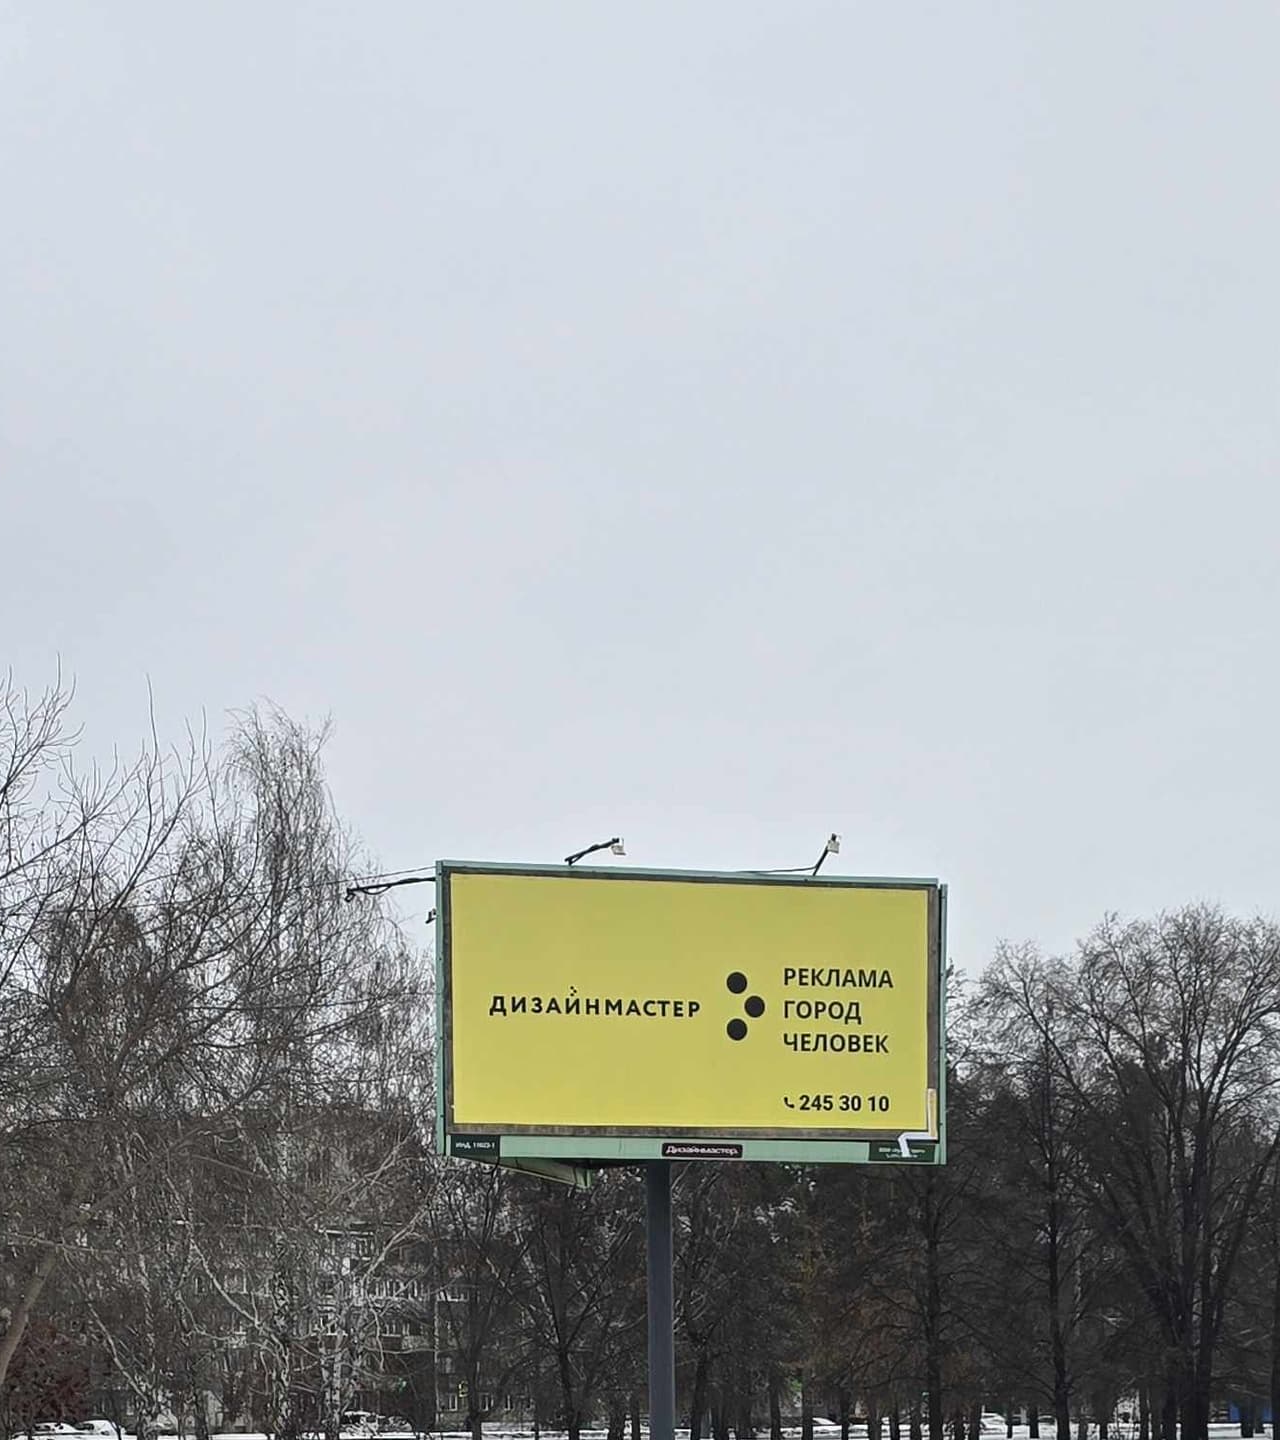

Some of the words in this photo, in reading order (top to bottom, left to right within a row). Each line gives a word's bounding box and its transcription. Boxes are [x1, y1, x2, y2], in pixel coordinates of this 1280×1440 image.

[783, 967, 894, 989] РЕКЛАМА
[489, 986, 700, 1018] ДИЗАЙНМАСТЕР
[784, 1000, 862, 1026] ГОРОД
[783, 1033, 889, 1054] ЧЕЛОВЕК
[799, 1094, 834, 1111] 245
[839, 1095, 862, 1112] 30
[867, 1095, 890, 1112] 10
